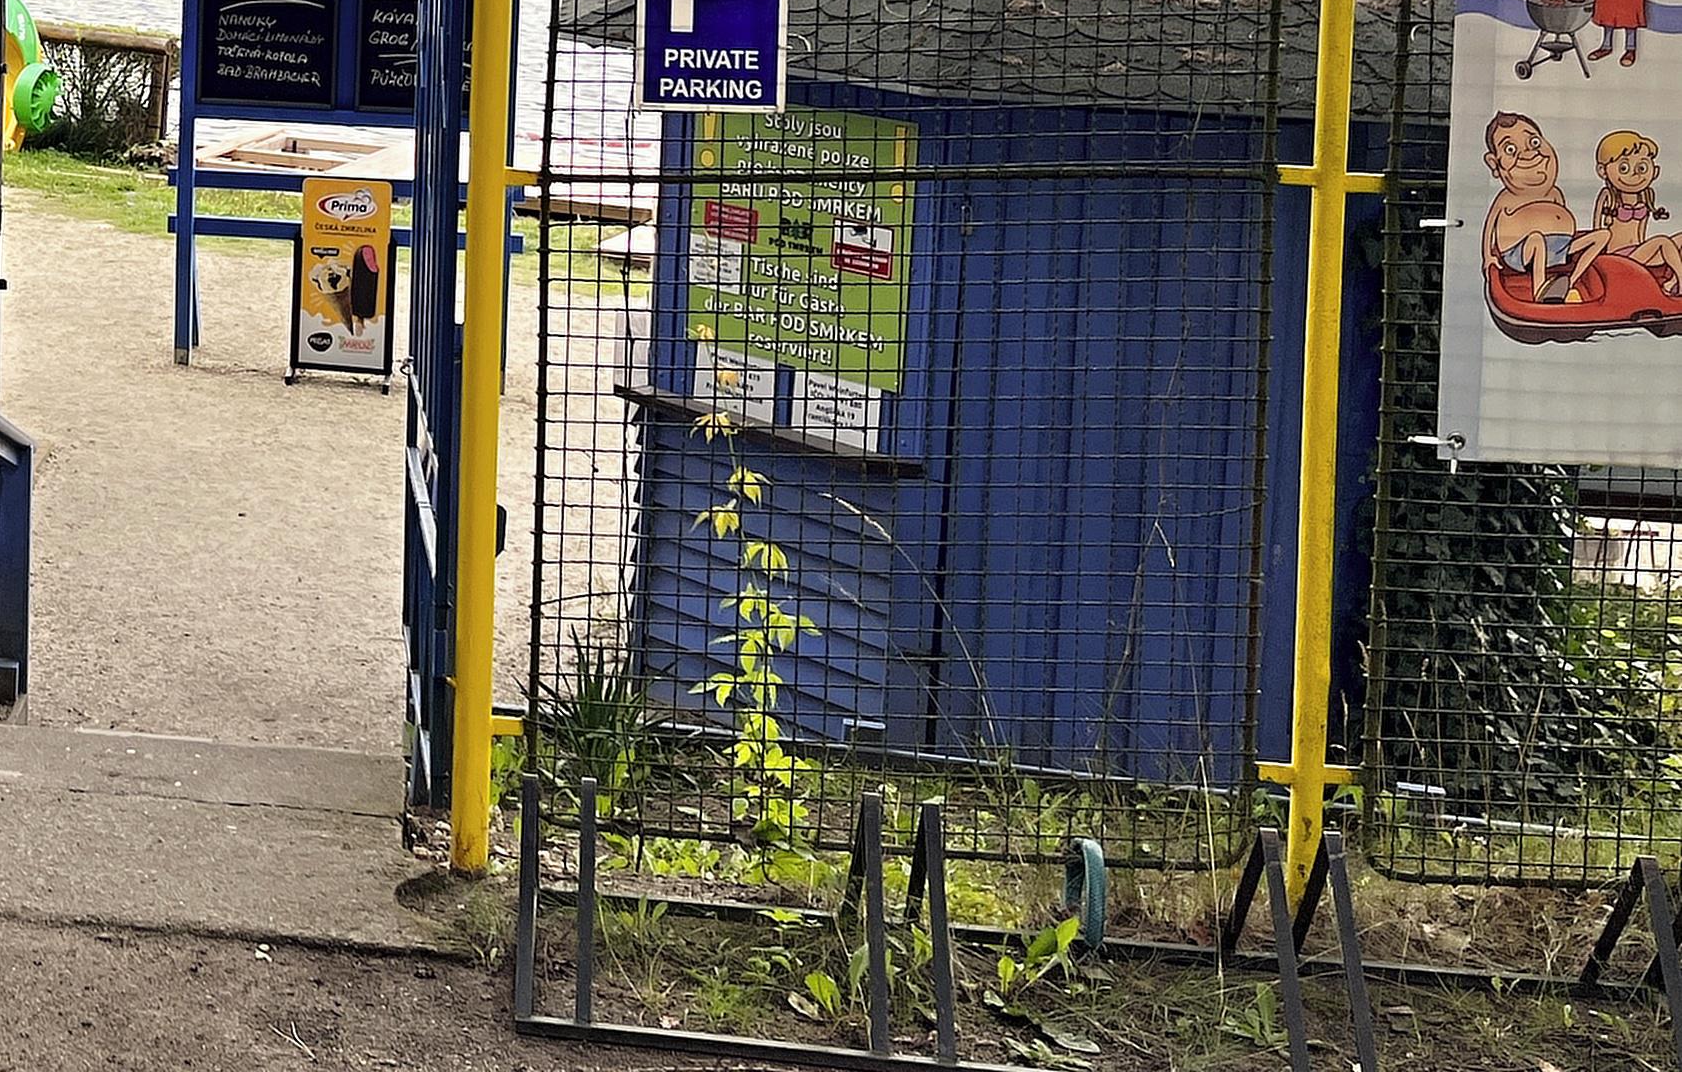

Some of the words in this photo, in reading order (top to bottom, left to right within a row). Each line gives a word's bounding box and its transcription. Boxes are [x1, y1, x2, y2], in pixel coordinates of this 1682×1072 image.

[664, 48, 760, 71] PRIVATE
[659, 78, 763, 100] PARKING
[330, 200, 368, 213] Prima
